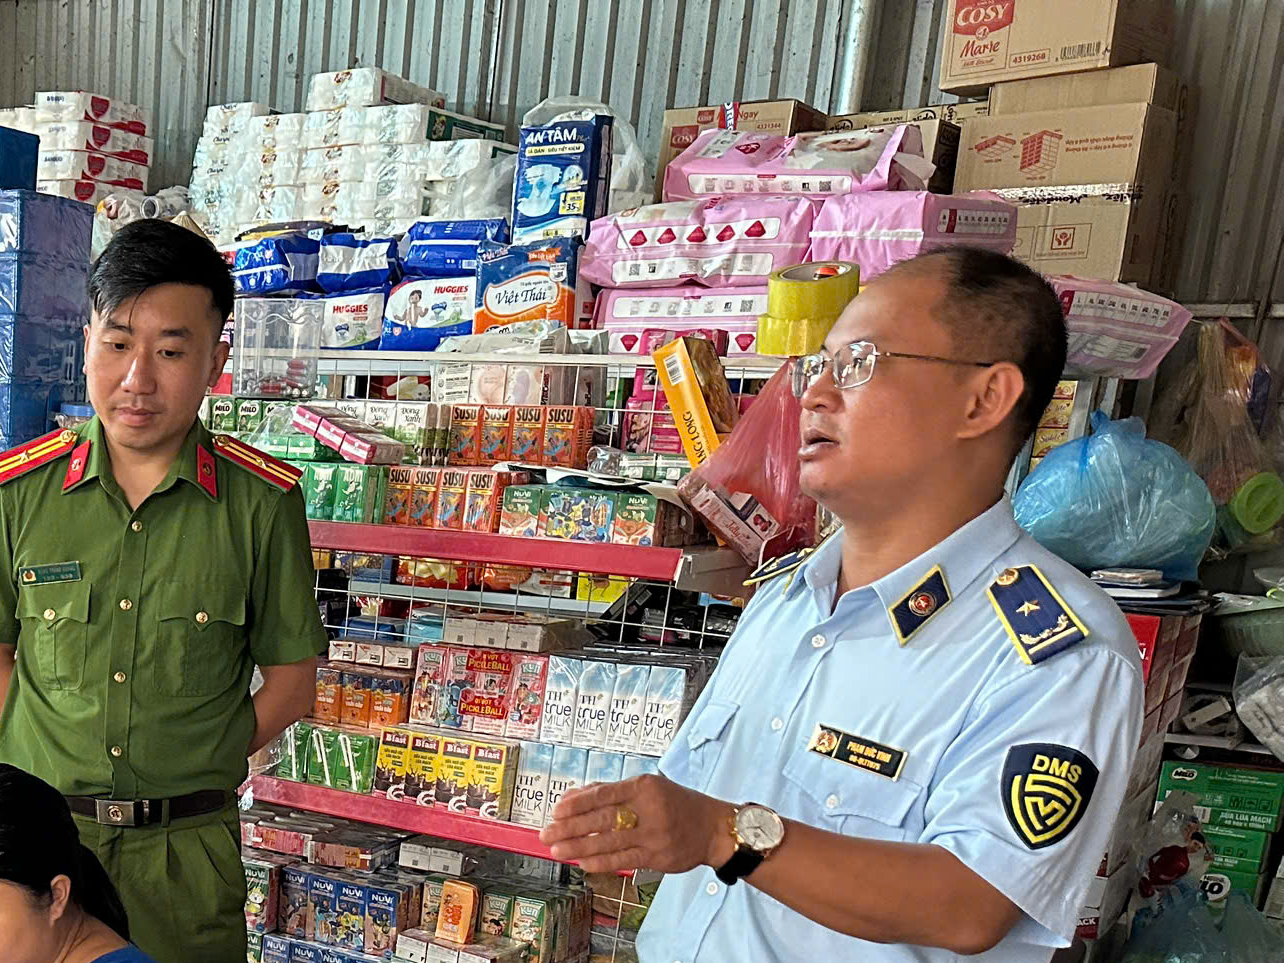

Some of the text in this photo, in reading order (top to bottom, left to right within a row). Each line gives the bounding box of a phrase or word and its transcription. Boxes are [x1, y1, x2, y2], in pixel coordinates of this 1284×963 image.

[957, 3, 1008, 26] COSY
[960, 40, 1000, 58] Marie
[672, 134, 696, 146] COSY
[434, 285, 469, 294] HUGGIES
[495, 286, 548, 306] Việt Thái
[332, 303, 368, 314] HUGGIES
[215, 405, 231, 414] MILO
[240, 406, 257, 414] MILO
[453, 407, 477, 421] SUSU
[516, 408, 541, 423] SUSU
[547, 408, 573, 423] SUSU
[680, 410, 701, 440] LONG
[389, 468, 412, 483] SUSU
[416, 470, 437, 485] SUSU
[443, 471, 465, 486] SUSU
[470, 472, 494, 488] SUSU
[547, 690, 562, 701] TH
[580, 694, 596, 705] TH
[545, 702, 572, 716] true
[613, 698, 630, 709] TH
[648, 702, 664, 714] TH
[544, 714, 571, 727] MILK
[577, 707, 605, 720] true
[611, 711, 639, 725] true
[576, 718, 604, 731] MILK
[645, 714, 673, 729] true
[610, 722, 638, 737] MILK
[643, 726, 673, 740] MILK
[1032, 754, 1082, 783] DMS
[518, 775, 533, 785] TH
[551, 780, 567, 790] TH
[516, 786, 543, 801] true
[514, 799, 542, 812] MILK
[1077, 917, 1096, 927] ACK
